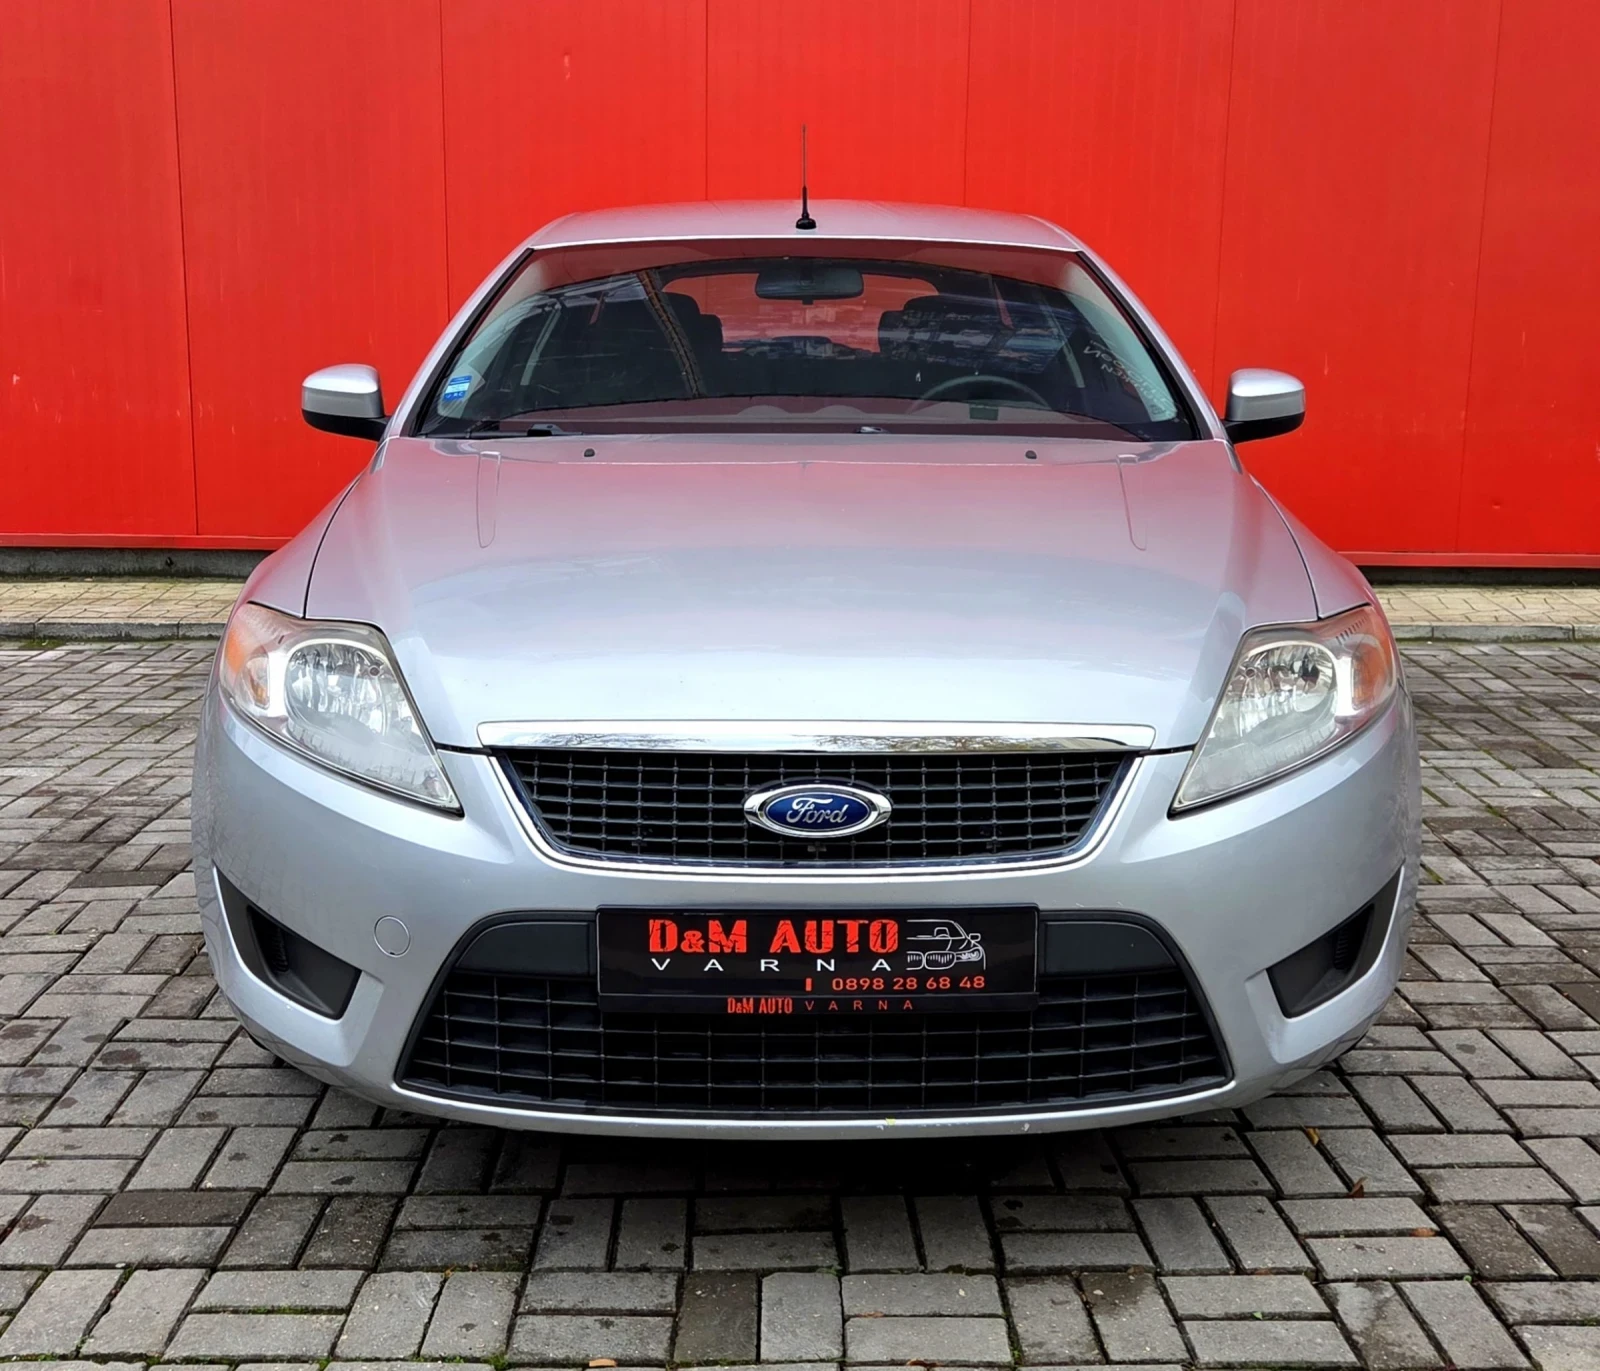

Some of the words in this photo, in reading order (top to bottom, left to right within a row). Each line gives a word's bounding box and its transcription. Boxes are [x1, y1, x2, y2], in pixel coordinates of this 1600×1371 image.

[785, 797, 849, 824] Ford
[648, 919, 748, 953] D&M
[769, 919, 899, 954] AUTO
[831, 977, 885, 991] 0898
[893, 977, 918, 991] 28
[926, 976, 951, 990] 68
[959, 976, 985, 990] 48
[728, 998, 754, 1013] D&M
[759, 998, 792, 1014] AUTO
